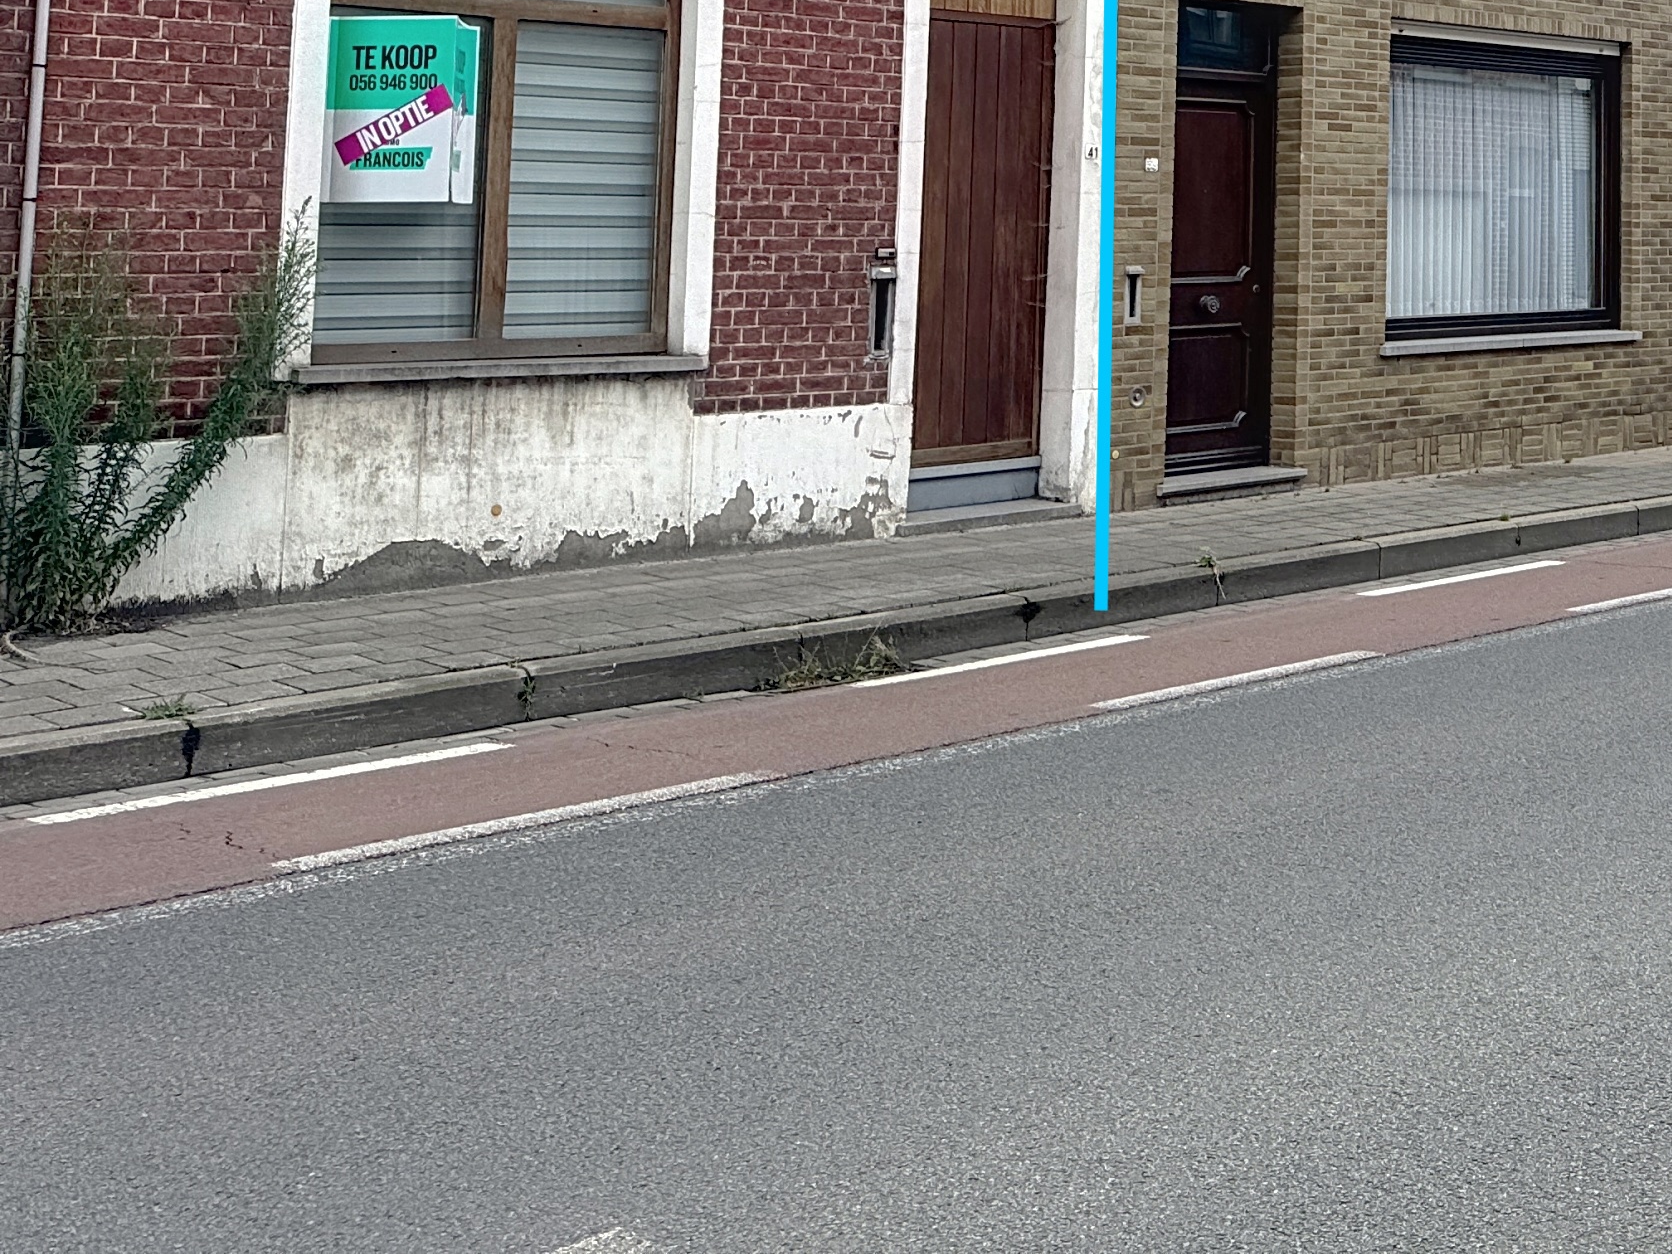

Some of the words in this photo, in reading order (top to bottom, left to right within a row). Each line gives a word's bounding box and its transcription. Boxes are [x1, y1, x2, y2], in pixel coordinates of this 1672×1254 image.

[352, 46, 377, 70] TE
[381, 45, 437, 70] KOOP
[350, 74, 376, 91] 056
[379, 74, 406, 91] 946
[410, 73, 438, 90] 900
[355, 123, 382, 154] IN
[378, 95, 434, 140] OPTIE
[1088, 147, 1098, 158] 41
